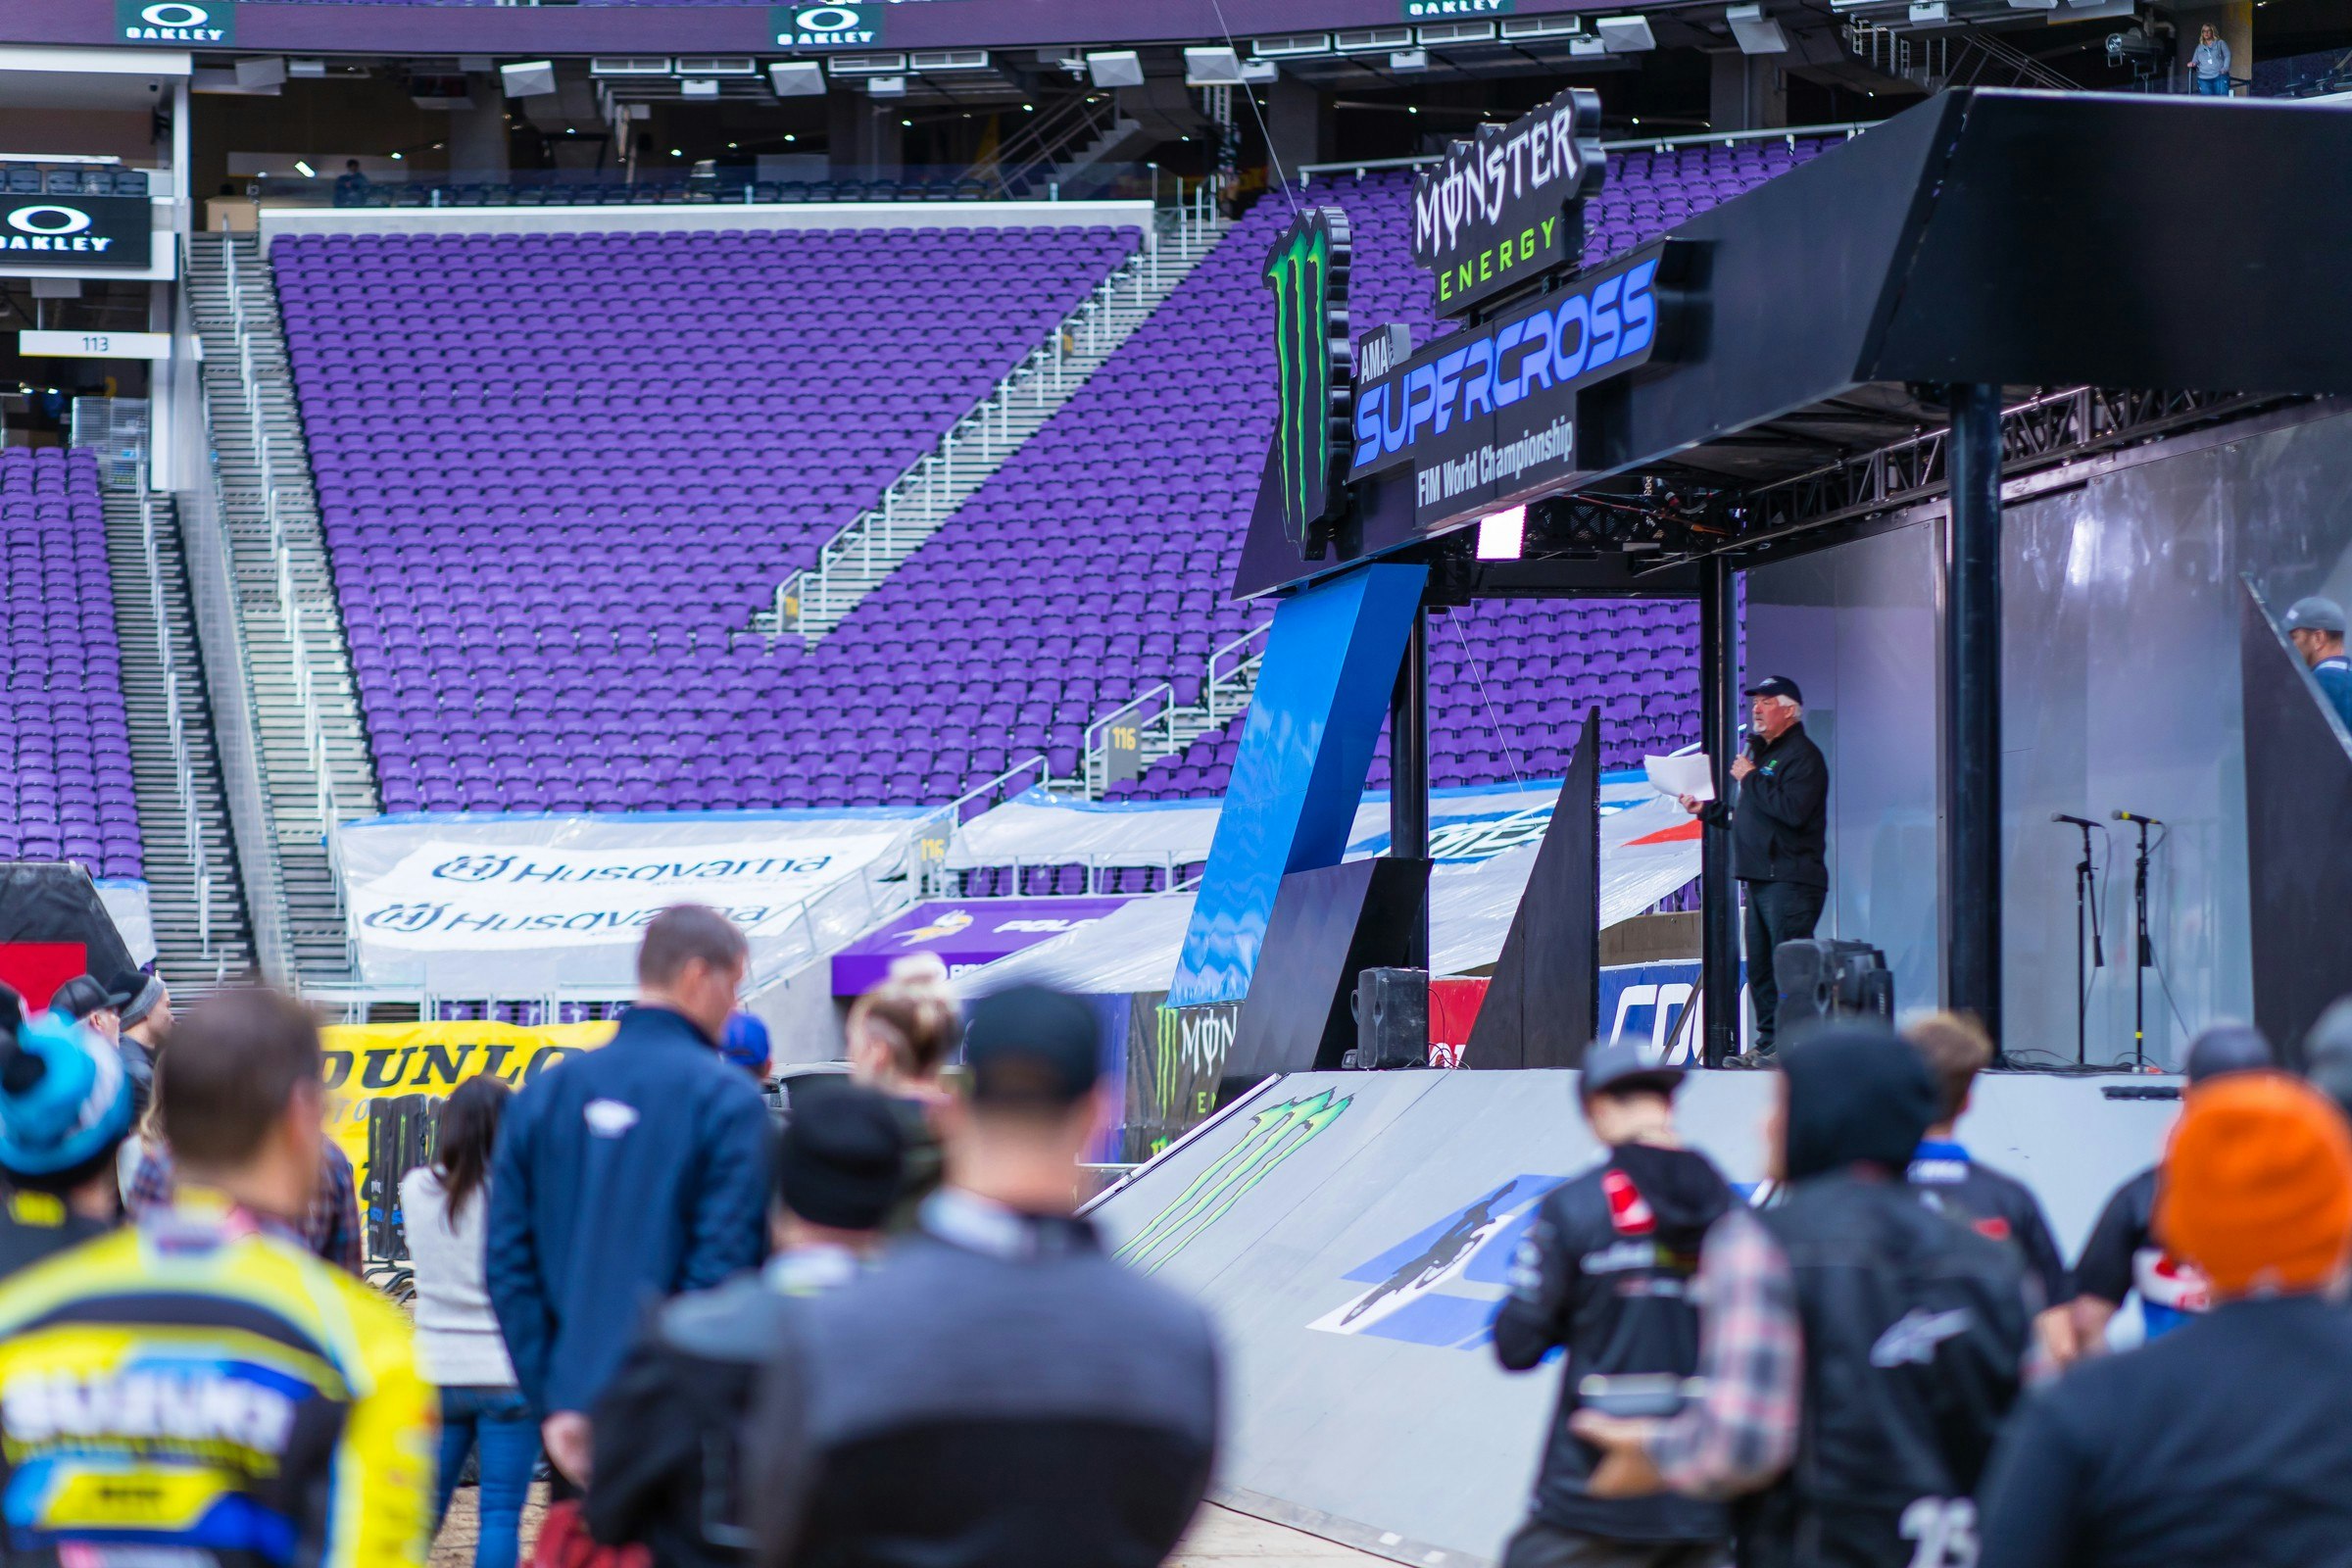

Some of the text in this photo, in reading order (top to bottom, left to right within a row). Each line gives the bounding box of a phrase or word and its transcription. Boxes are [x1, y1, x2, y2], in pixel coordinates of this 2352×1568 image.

[1409, 0, 1501, 16] OAKLEY
[125, 26, 224, 41] OAKLEY
[777, 31, 876, 46] OAKLEY
[1416, 104, 1578, 258] MONSTER
[1440, 217, 1556, 302] ENERGY
[82, 337, 110, 352] 113
[1354, 258, 1657, 468] SUPERCROSS
[1360, 335, 1390, 385] AMA
[1418, 415, 1574, 508] FIM World Championship
[1112, 726, 1137, 751] 116
[510, 855, 832, 883] Husqvarna
[443, 906, 769, 932] Husqvaa
